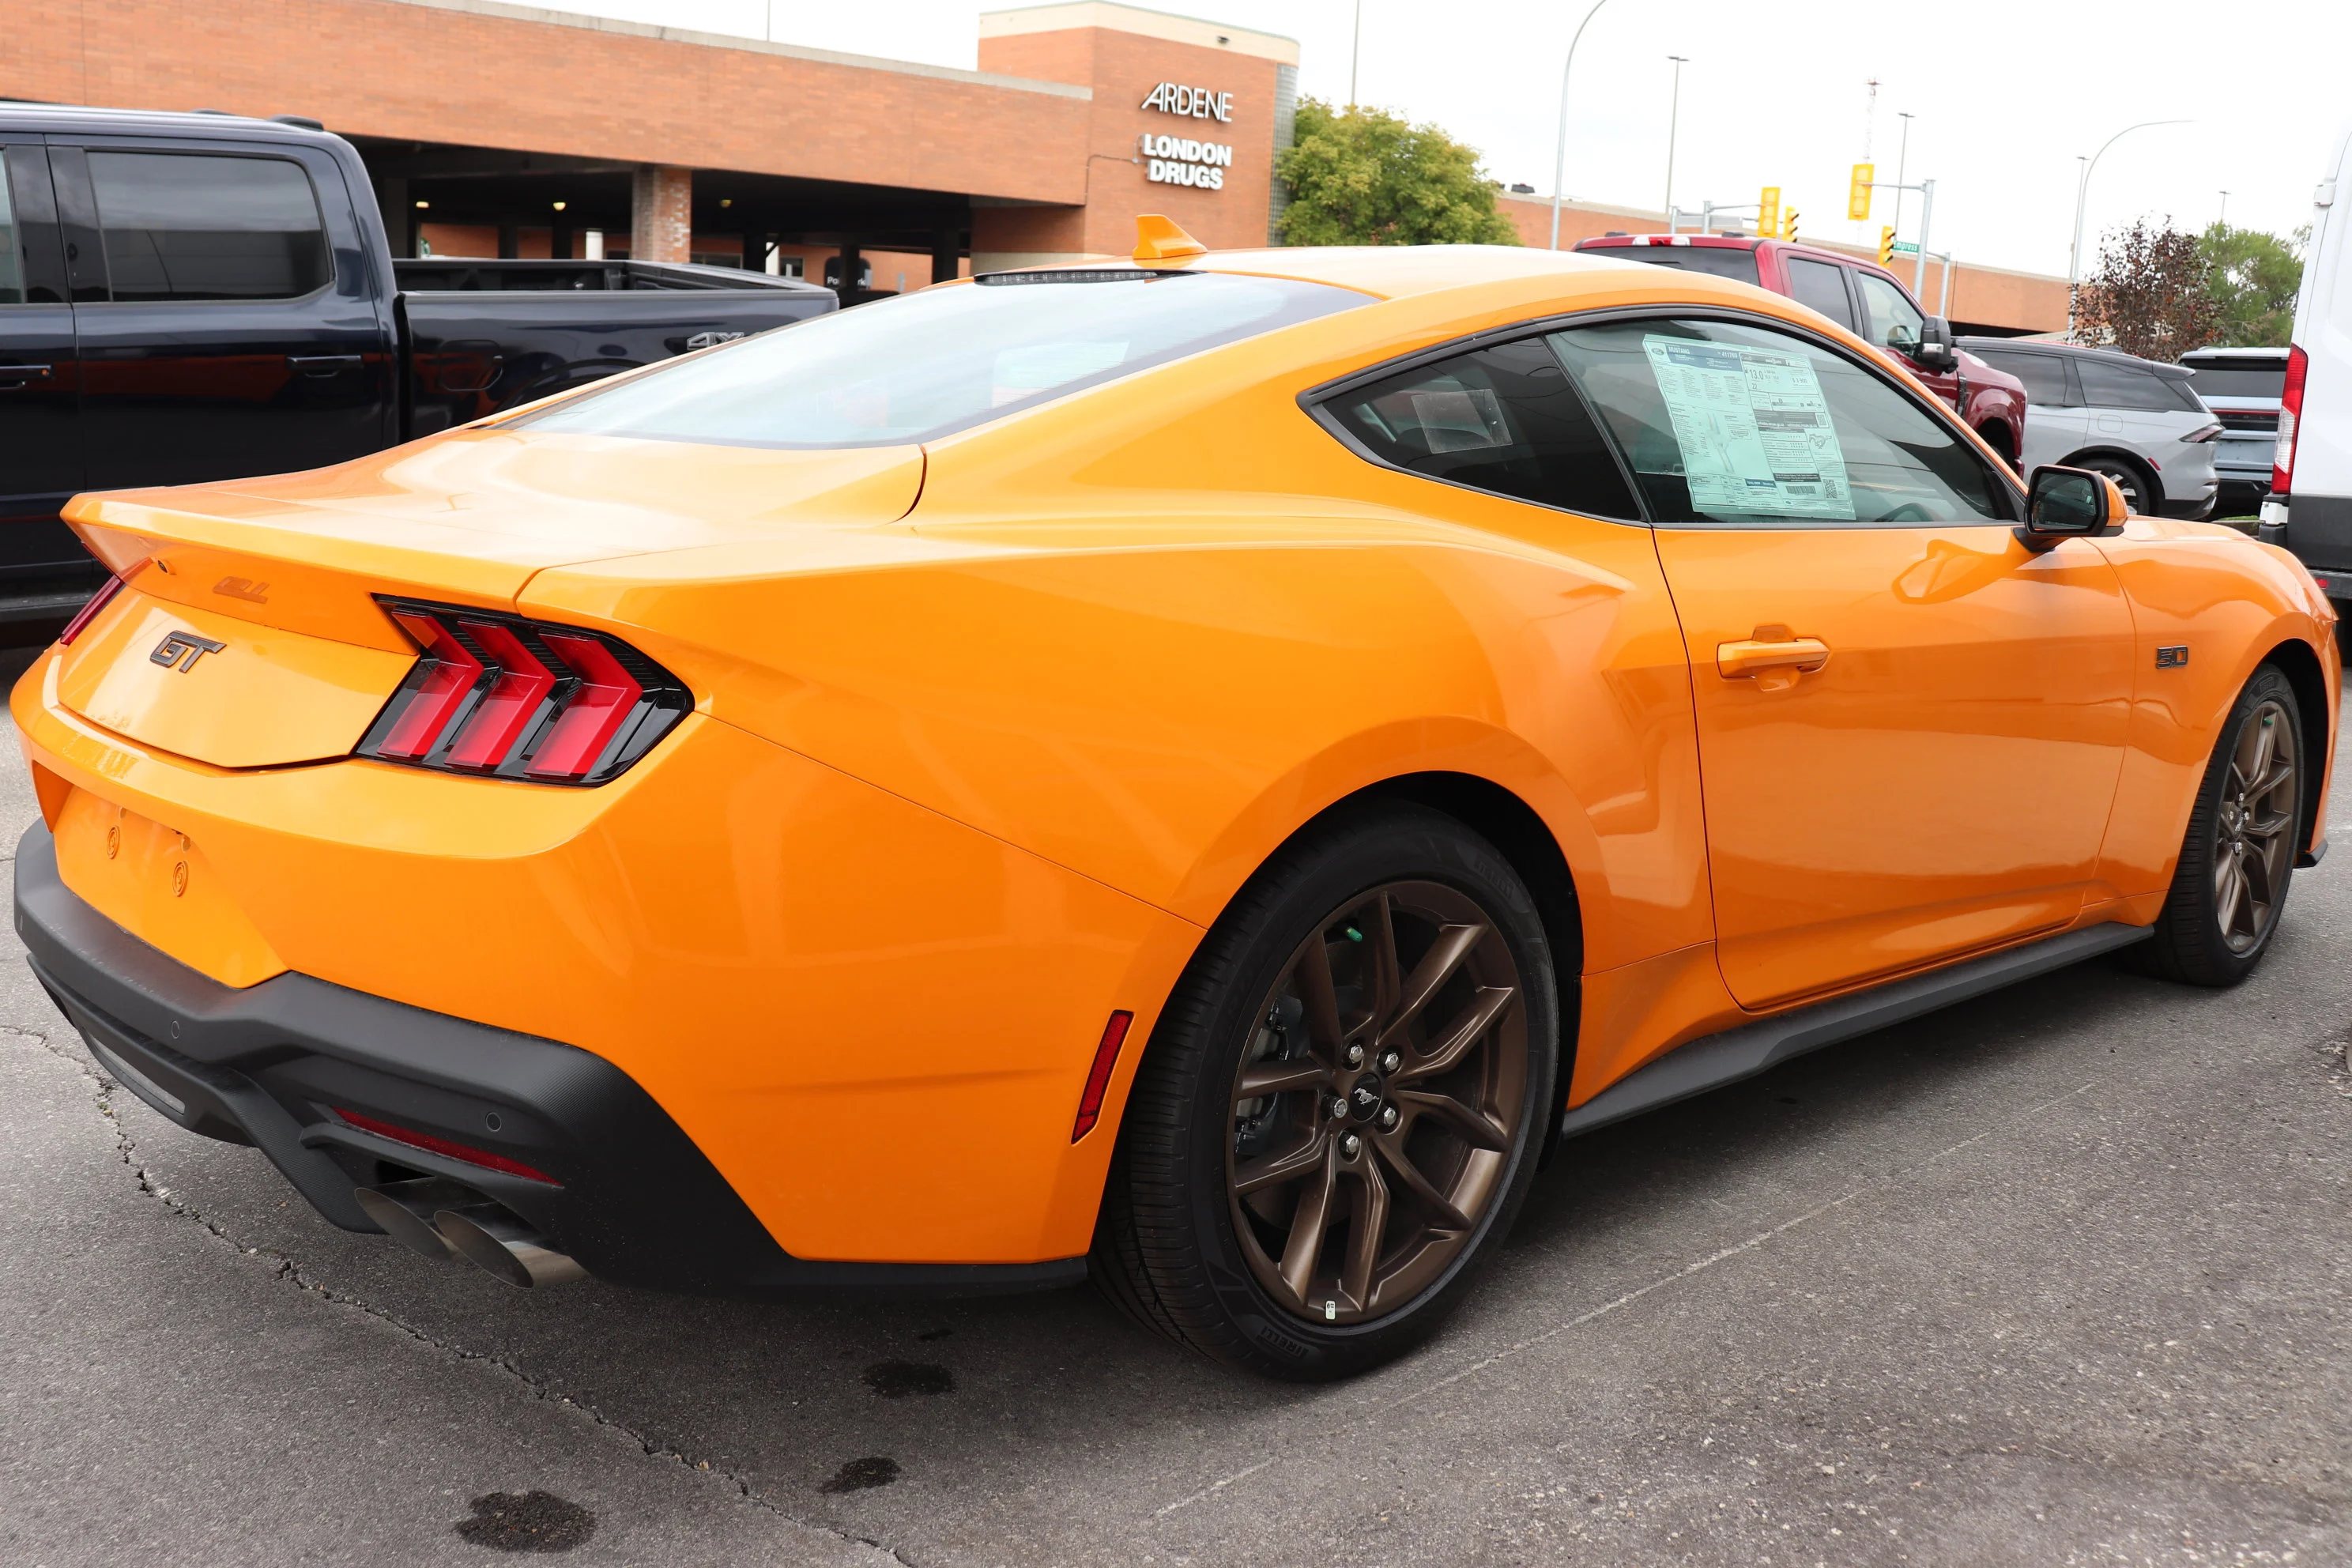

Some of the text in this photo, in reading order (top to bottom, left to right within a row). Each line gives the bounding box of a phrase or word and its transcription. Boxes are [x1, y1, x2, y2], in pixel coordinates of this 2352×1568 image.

[1140, 82, 1234, 122] ARDENE
[1144, 134, 1232, 167] LONDON
[1148, 159, 1223, 190] DRUGS
[686, 332, 744, 351] 4X
[1668, 346, 1690, 355] MUSTANG
[1750, 369, 1764, 380] 13.0
[149, 630, 228, 674] GT
[2155, 645, 2188, 669] 5.0
